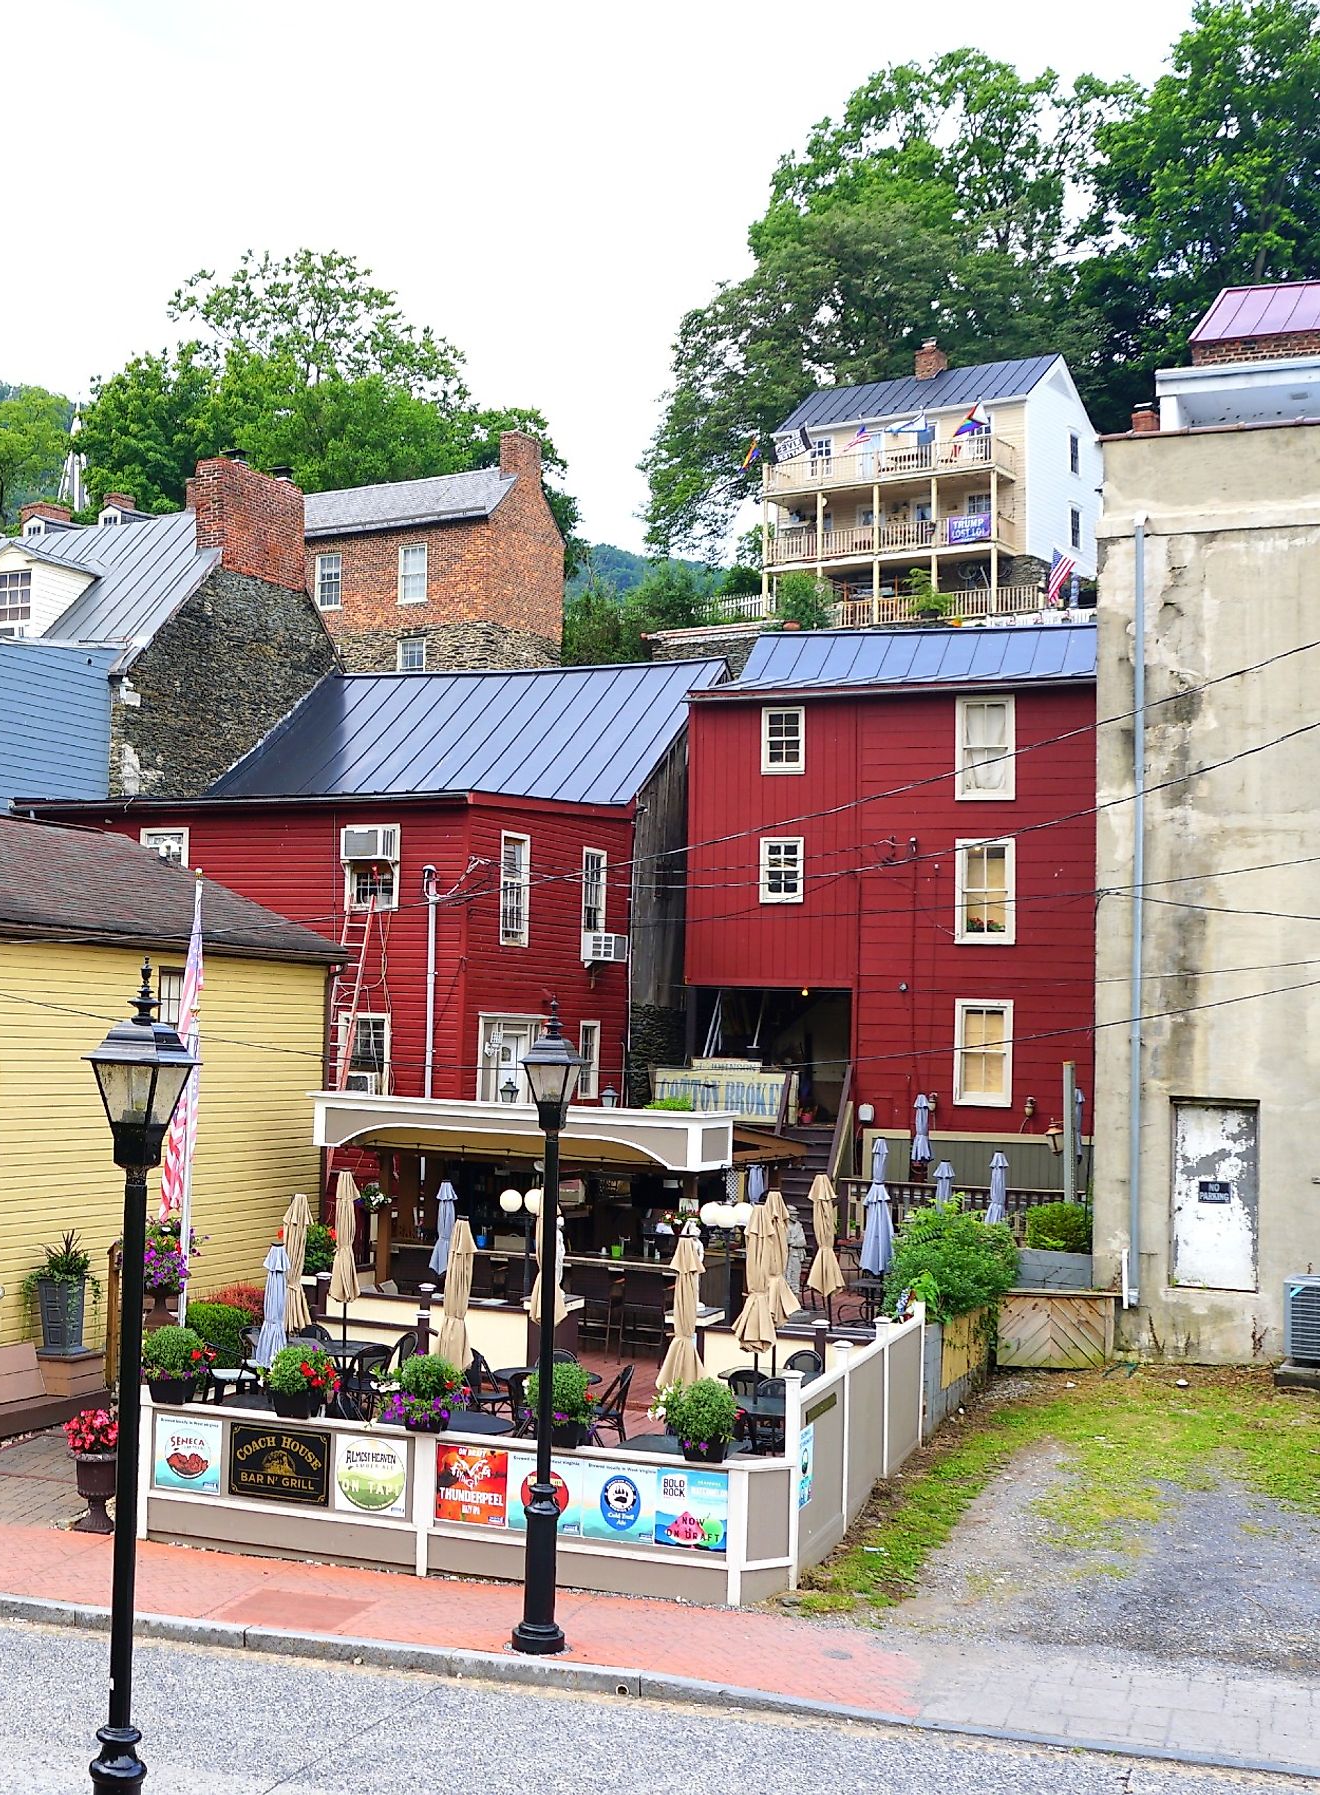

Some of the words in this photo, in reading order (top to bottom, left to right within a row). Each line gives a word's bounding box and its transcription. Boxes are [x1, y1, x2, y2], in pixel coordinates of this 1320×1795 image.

[953, 518, 984, 530] TRUMP
[952, 528, 971, 540] LOST
[725, 1081, 784, 1116] BROKE
[1209, 1183, 1220, 1192] NO
[1200, 1191, 1229, 1201] PARKING
[170, 1436, 205, 1447] SENECA
[236, 1436, 276, 1461] COACH
[281, 1435, 322, 1471] HOUSE
[346, 1450, 371, 1463] ALMOST
[371, 1452, 396, 1464] HEAVEN
[240, 1471, 264, 1484] BAR
[267, 1475, 278, 1485] N'
[281, 1477, 315, 1490] GRILL
[341, 1478, 360, 1493] ON
[663, 1478, 685, 1488] BOLD
[439, 1487, 504, 1507] THUNDERPEEL
[663, 1488, 685, 1498] ROCK
[682, 1516, 705, 1527] NOW
[666, 1528, 680, 1538] ON
[684, 1530, 720, 1542] DRAFT
